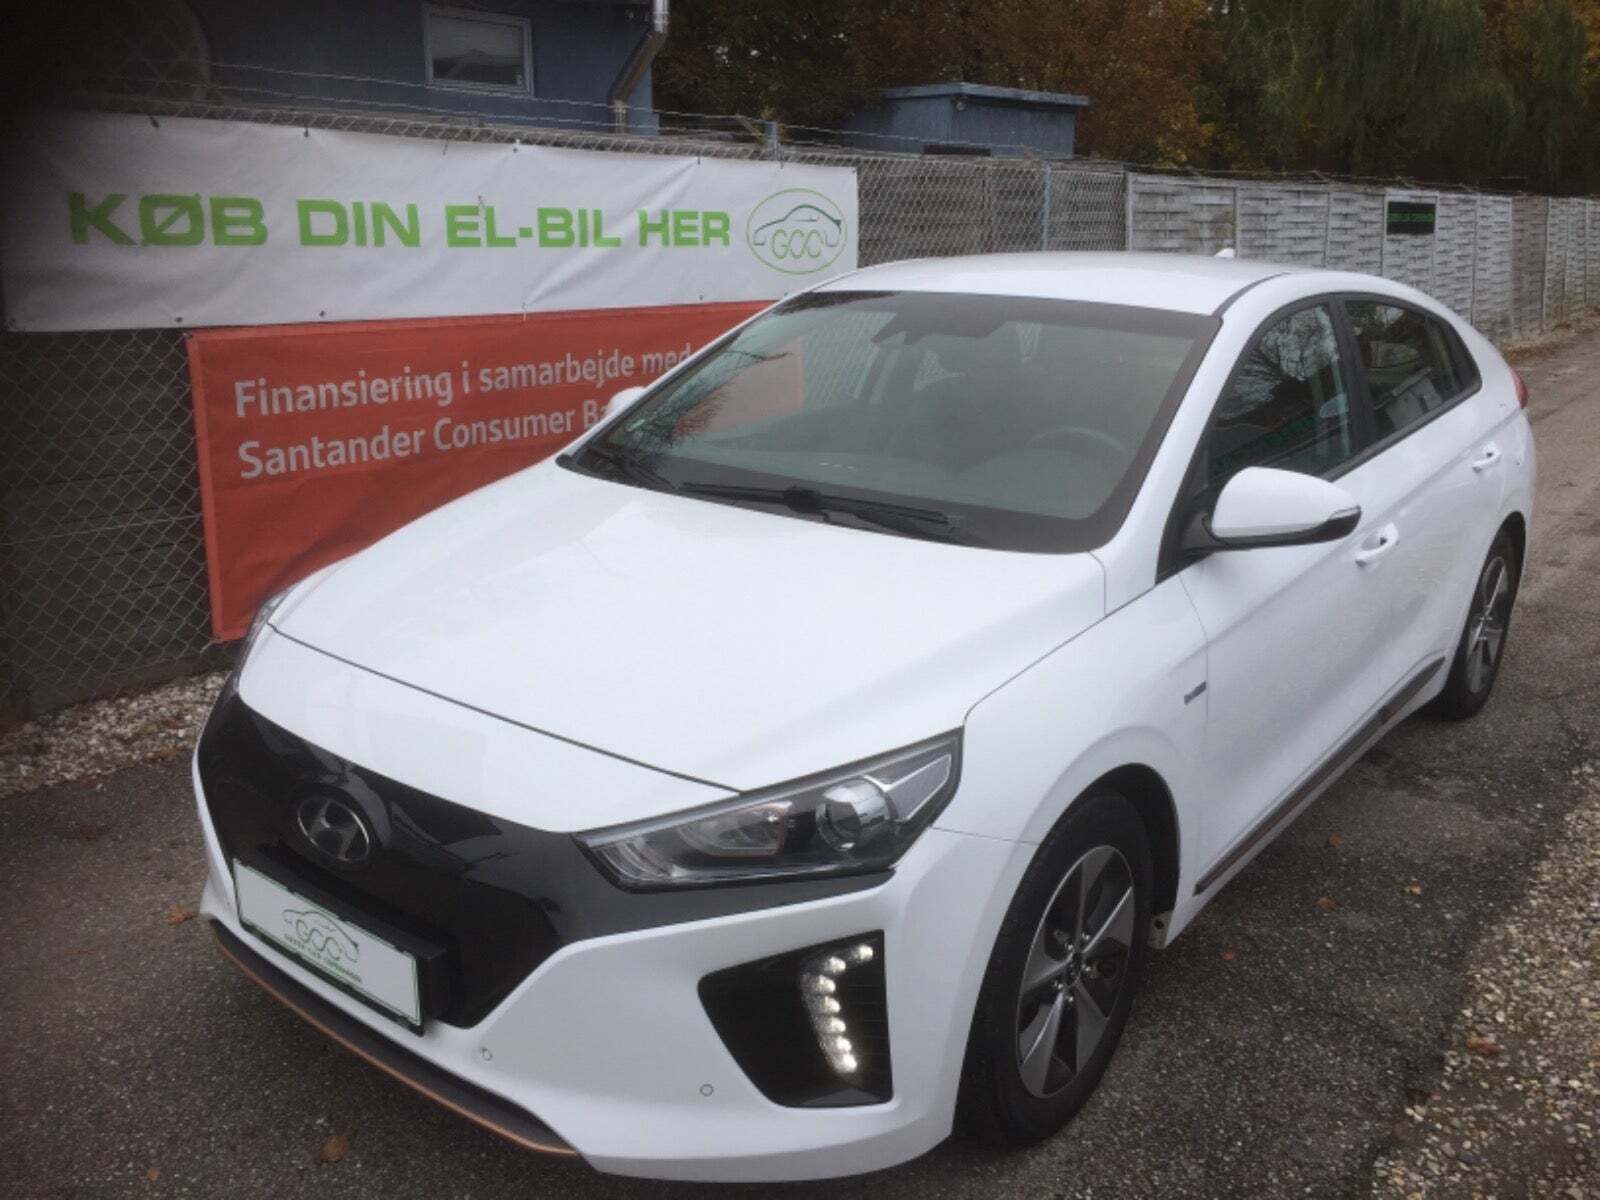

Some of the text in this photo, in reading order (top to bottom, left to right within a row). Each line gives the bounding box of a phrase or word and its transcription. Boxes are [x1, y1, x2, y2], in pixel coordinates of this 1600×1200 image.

[68, 192, 731, 249] KØB DIN EL-BIL HER
[234, 366, 454, 417] Finansiering
[461, 360, 471, 394] i
[479, 348, 635, 392] samarbejde
[238, 424, 426, 479] Santander
[433, 407, 575, 451] Consumer
